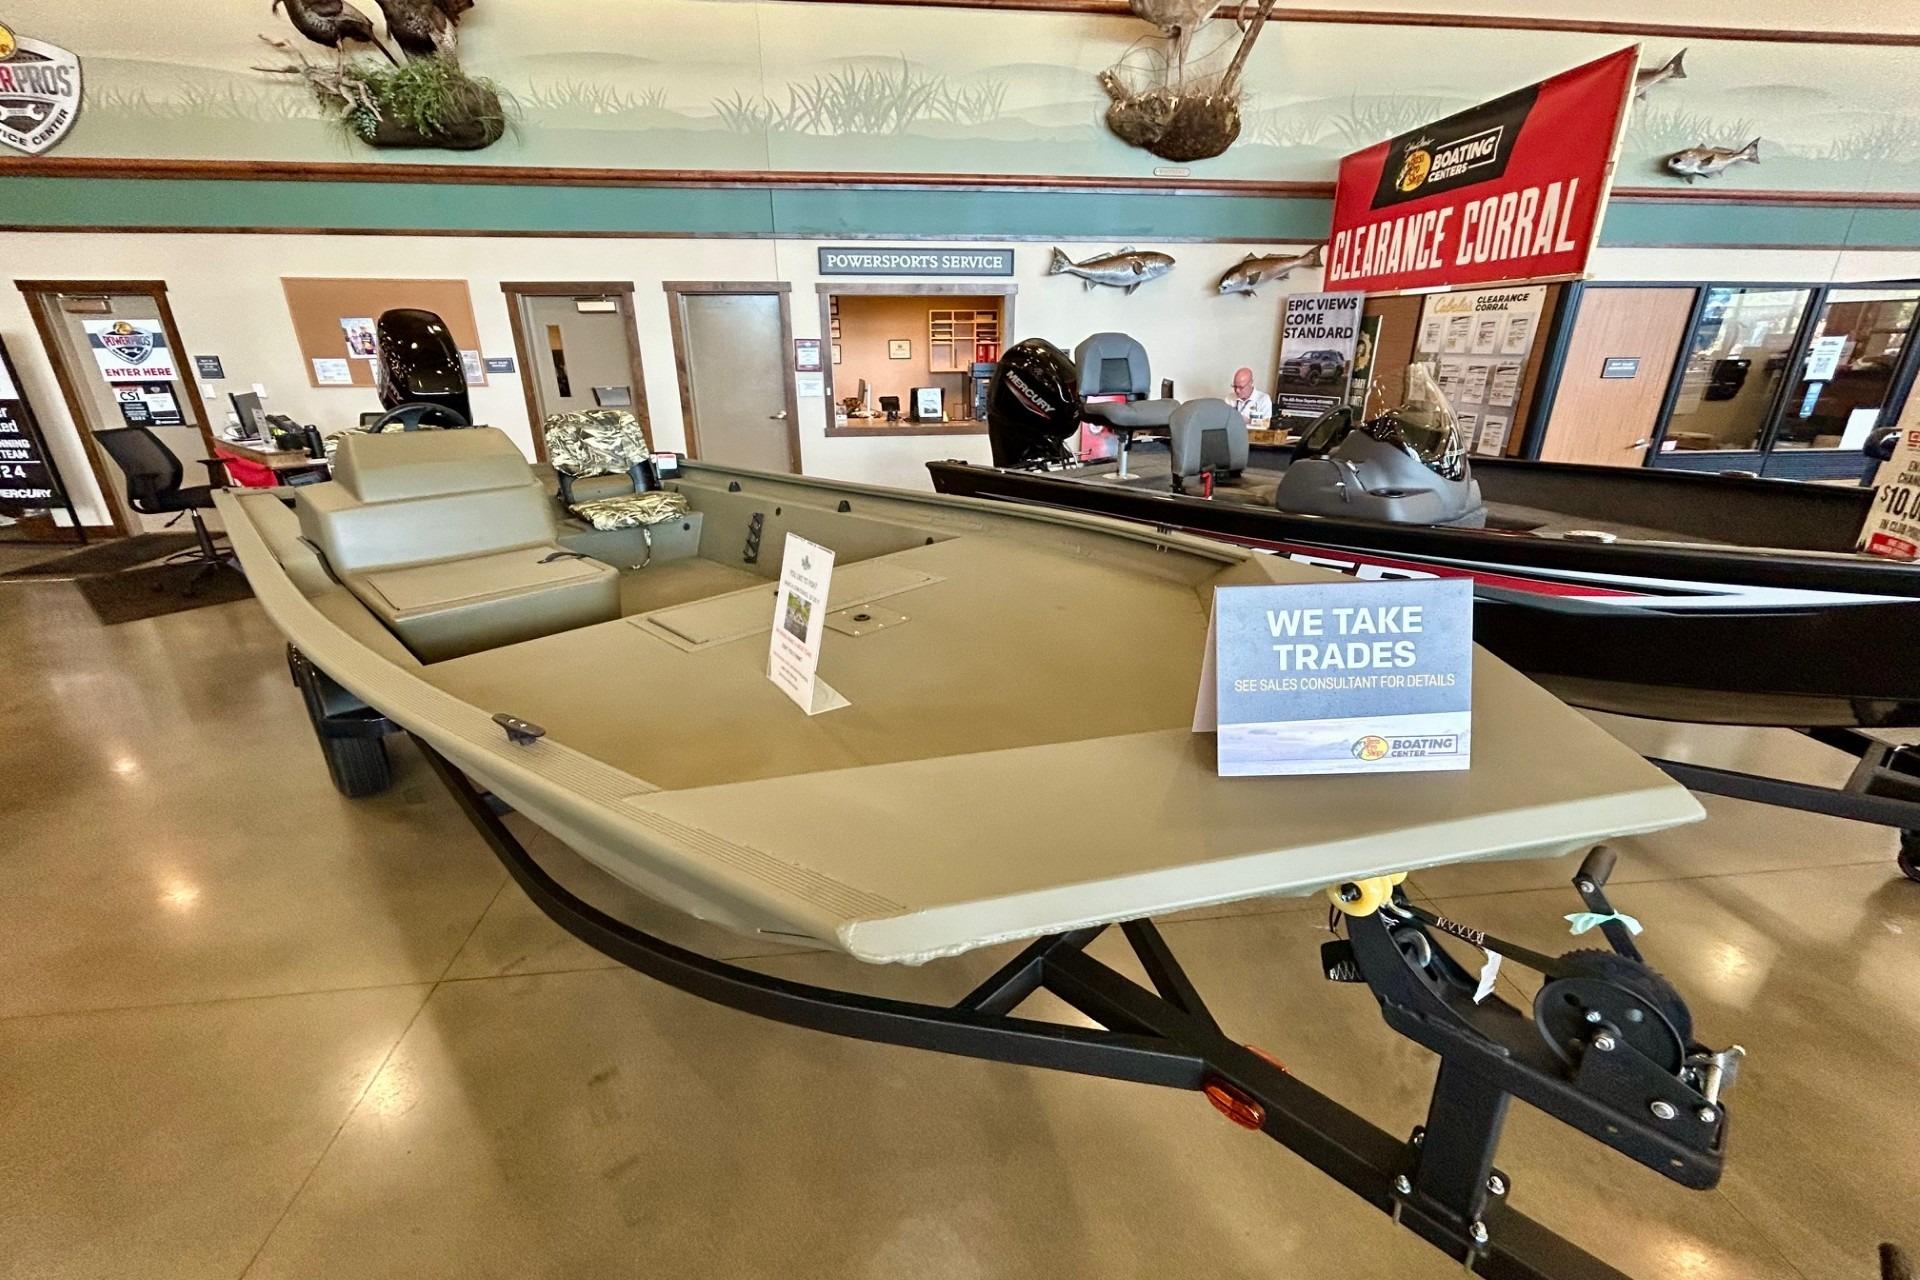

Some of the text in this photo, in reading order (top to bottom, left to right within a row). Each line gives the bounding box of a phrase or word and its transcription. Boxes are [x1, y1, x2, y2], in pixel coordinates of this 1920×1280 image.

[0, 65, 72, 97] RPROS
[32, 108, 69, 145] CENTER
[1430, 136, 1496, 171] BOATING
[1428, 162, 1468, 182] CENTERS
[1330, 177, 1579, 281] CLEARANCE CORRAL
[827, 254, 1002, 269] POWERSPORTS SERVICE
[1288, 297, 1358, 311] EPIC VIEWS
[1477, 293, 1530, 304] CLEARANCE
[1475, 302, 1509, 312] CORRAL
[1286, 313, 1324, 325] COME
[1284, 326, 1353, 339] STANDARD
[105, 367, 172, 377] ENTER HERE
[1006, 370, 1056, 412] MERCURY
[1, 449, 29, 459] TEAM
[0, 488, 52, 498] ERCURY
[1267, 605, 1423, 637] WE TAKE
[1273, 640, 1417, 671] TRADES
[1234, 673, 1456, 692] SEE SALES CONSULTANT FOR DETAILS
[1392, 738, 1453, 750] BOATING
[1391, 750, 1426, 758] CENTER
